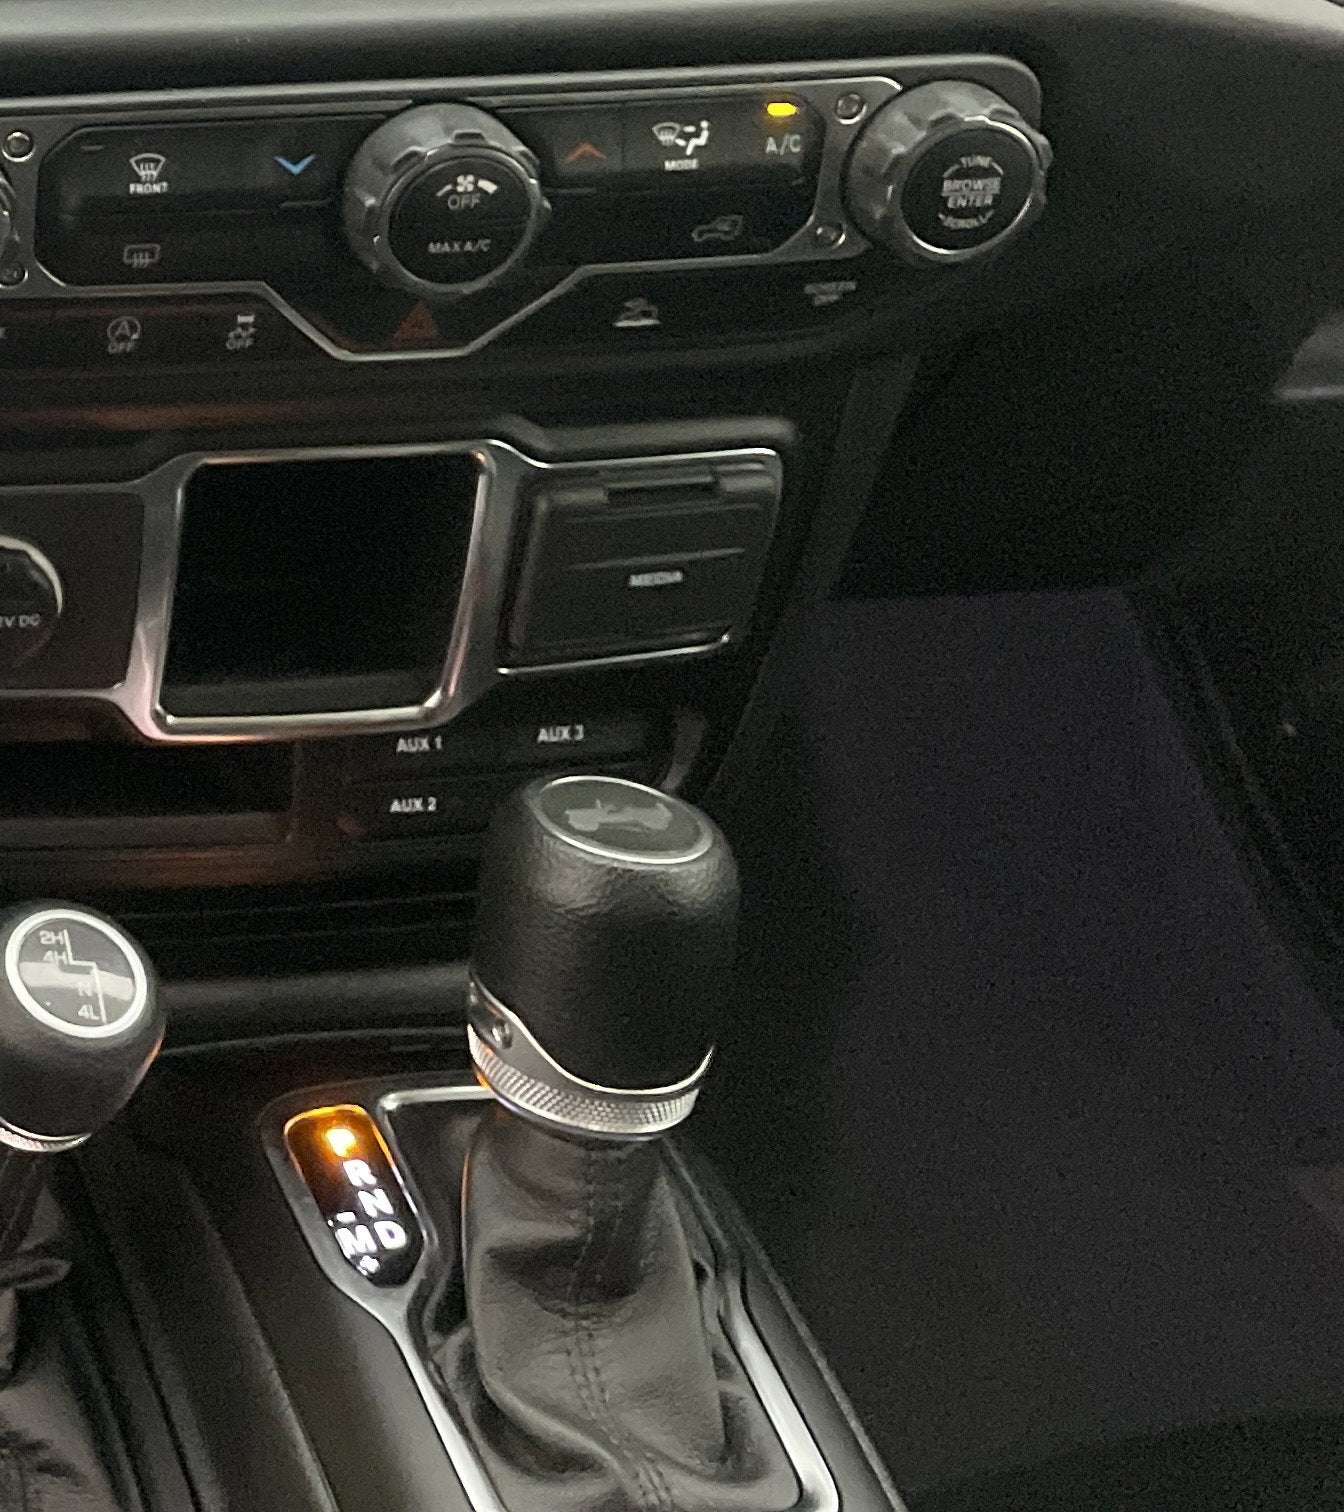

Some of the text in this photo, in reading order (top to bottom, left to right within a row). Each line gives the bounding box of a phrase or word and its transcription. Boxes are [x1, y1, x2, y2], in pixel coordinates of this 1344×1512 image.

[765, 134, 802, 156] A/C
[448, 193, 480, 210] OFF
[17, 613, 41, 628] DC
[536, 726, 572, 743] AUX
[396, 734, 443, 753] AUX 1
[389, 796, 437, 813] AUX 2
[39, 929, 64, 945] 2H
[43, 950, 68, 965] 4H
[77, 1003, 100, 1020] 4L
[342, 1159, 377, 1187] R
[357, 1188, 394, 1218] N
[335, 1224, 378, 1256] M
[374, 1220, 406, 1250] D
